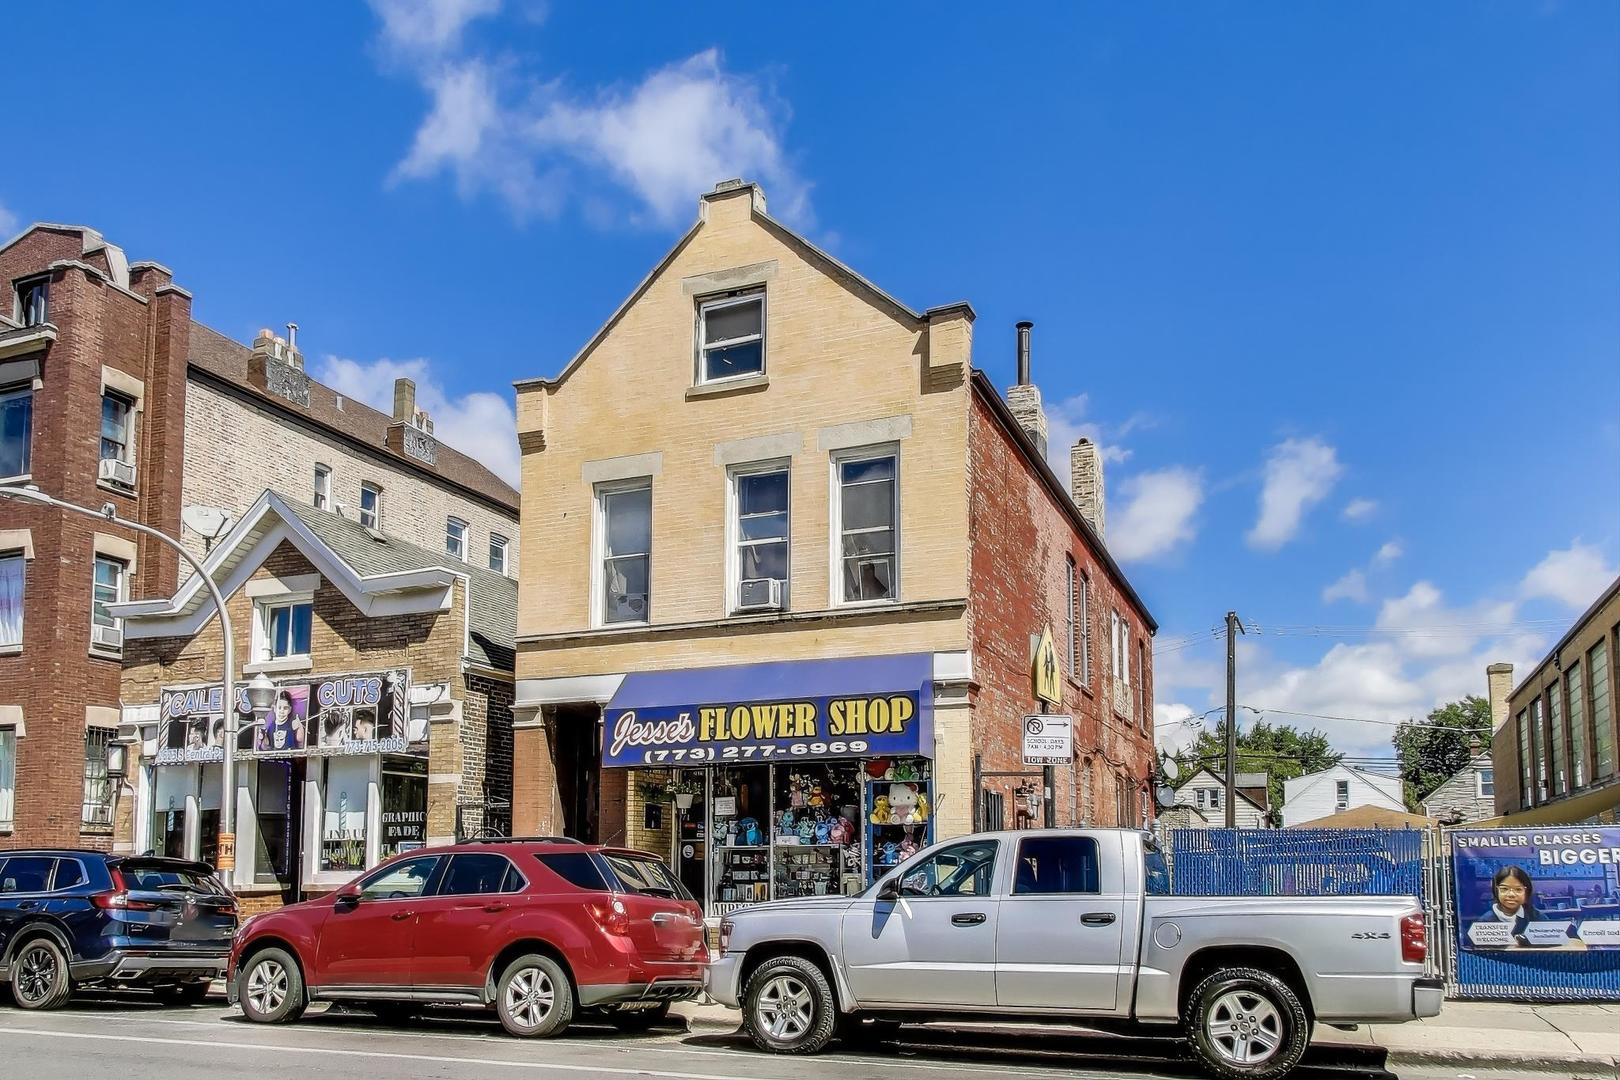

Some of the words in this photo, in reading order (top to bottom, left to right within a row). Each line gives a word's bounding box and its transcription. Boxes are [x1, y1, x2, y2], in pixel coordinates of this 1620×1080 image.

[169, 687, 253, 717] CALE'S
[317, 678, 382, 707] CUTS
[610, 711, 695, 757] Jesse's
[698, 702, 817, 742] FLOWER
[829, 696, 914, 736] SHOP
[644, 747, 714, 763] (773)
[722, 740, 868, 758] 277-6969
[382, 811, 425, 823] GRAPHIC
[388, 826, 420, 837] FADE
[1457, 835, 1528, 848] SMALLER
[1533, 833, 1602, 846] CLASSES
